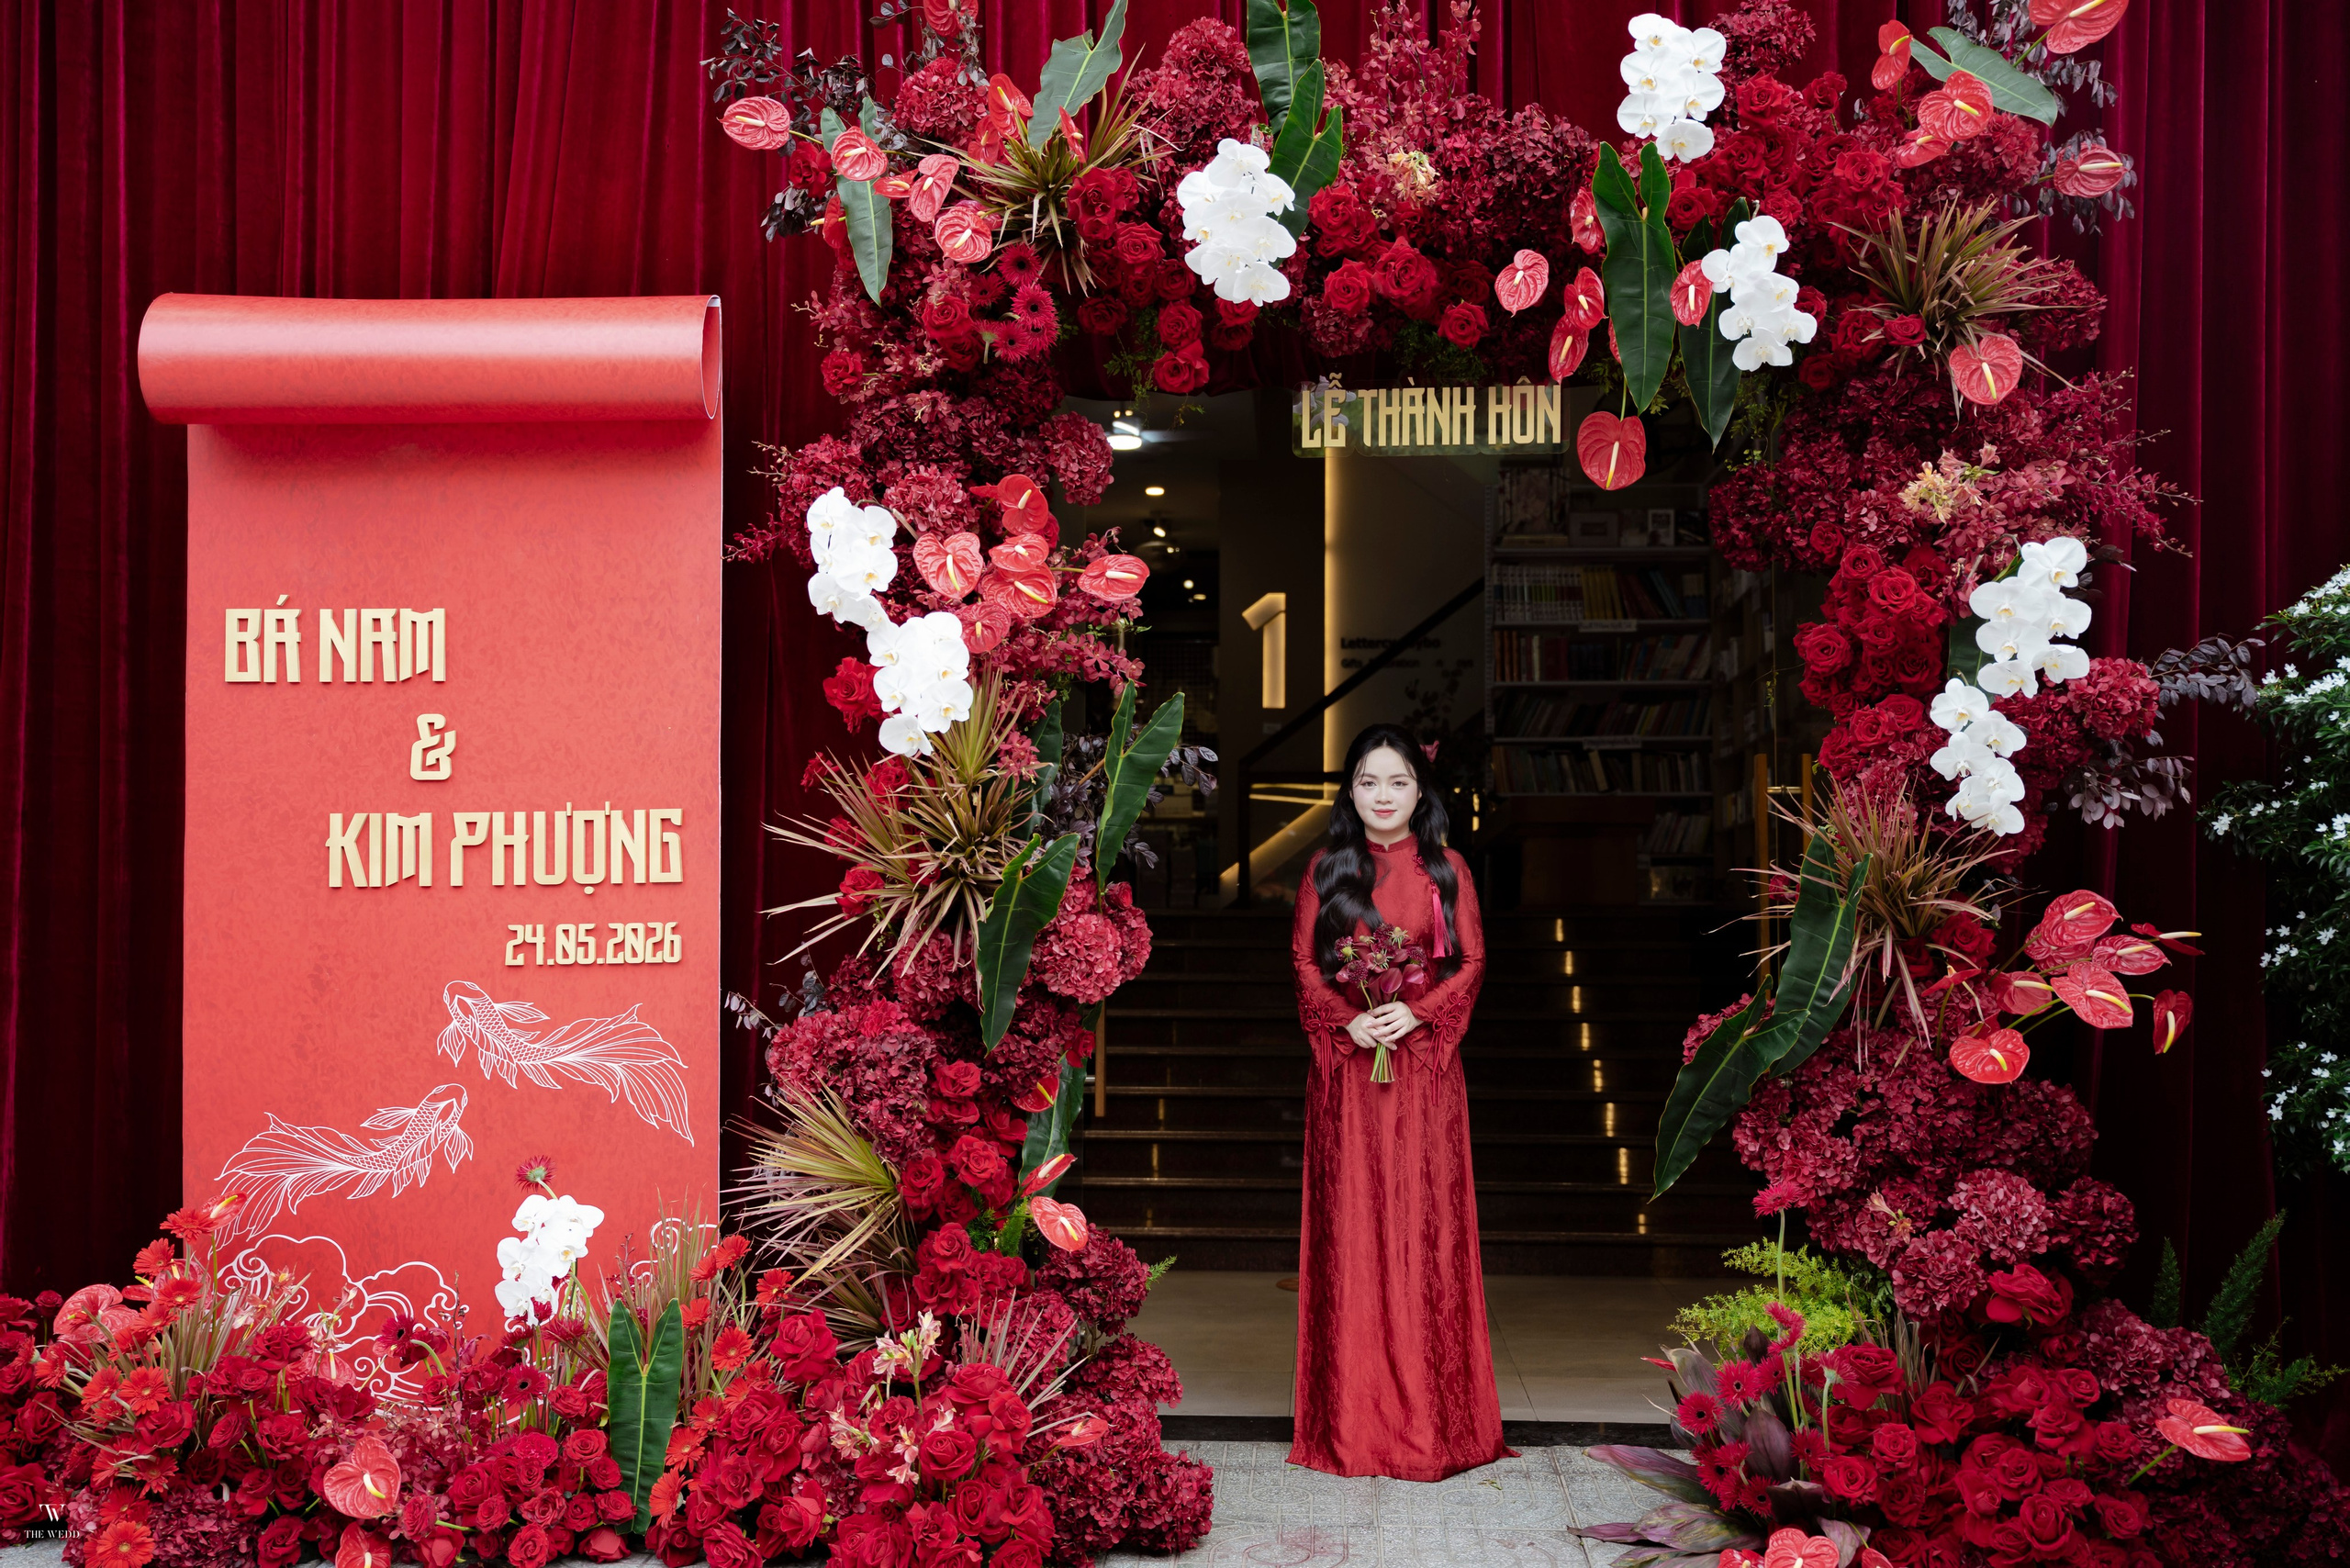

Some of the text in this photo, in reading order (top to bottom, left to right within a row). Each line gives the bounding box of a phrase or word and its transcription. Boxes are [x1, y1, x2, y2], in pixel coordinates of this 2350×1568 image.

[1301, 372, 1562, 449] LỄ THÀNH HÔN
[224, 594, 446, 684] BÁ NAM
[1241, 591, 1287, 709] 1
[409, 712, 457, 781] &
[325, 801, 684, 895] KIM PHƯỢNG
[505, 921, 683, 967] 24.05.2026
